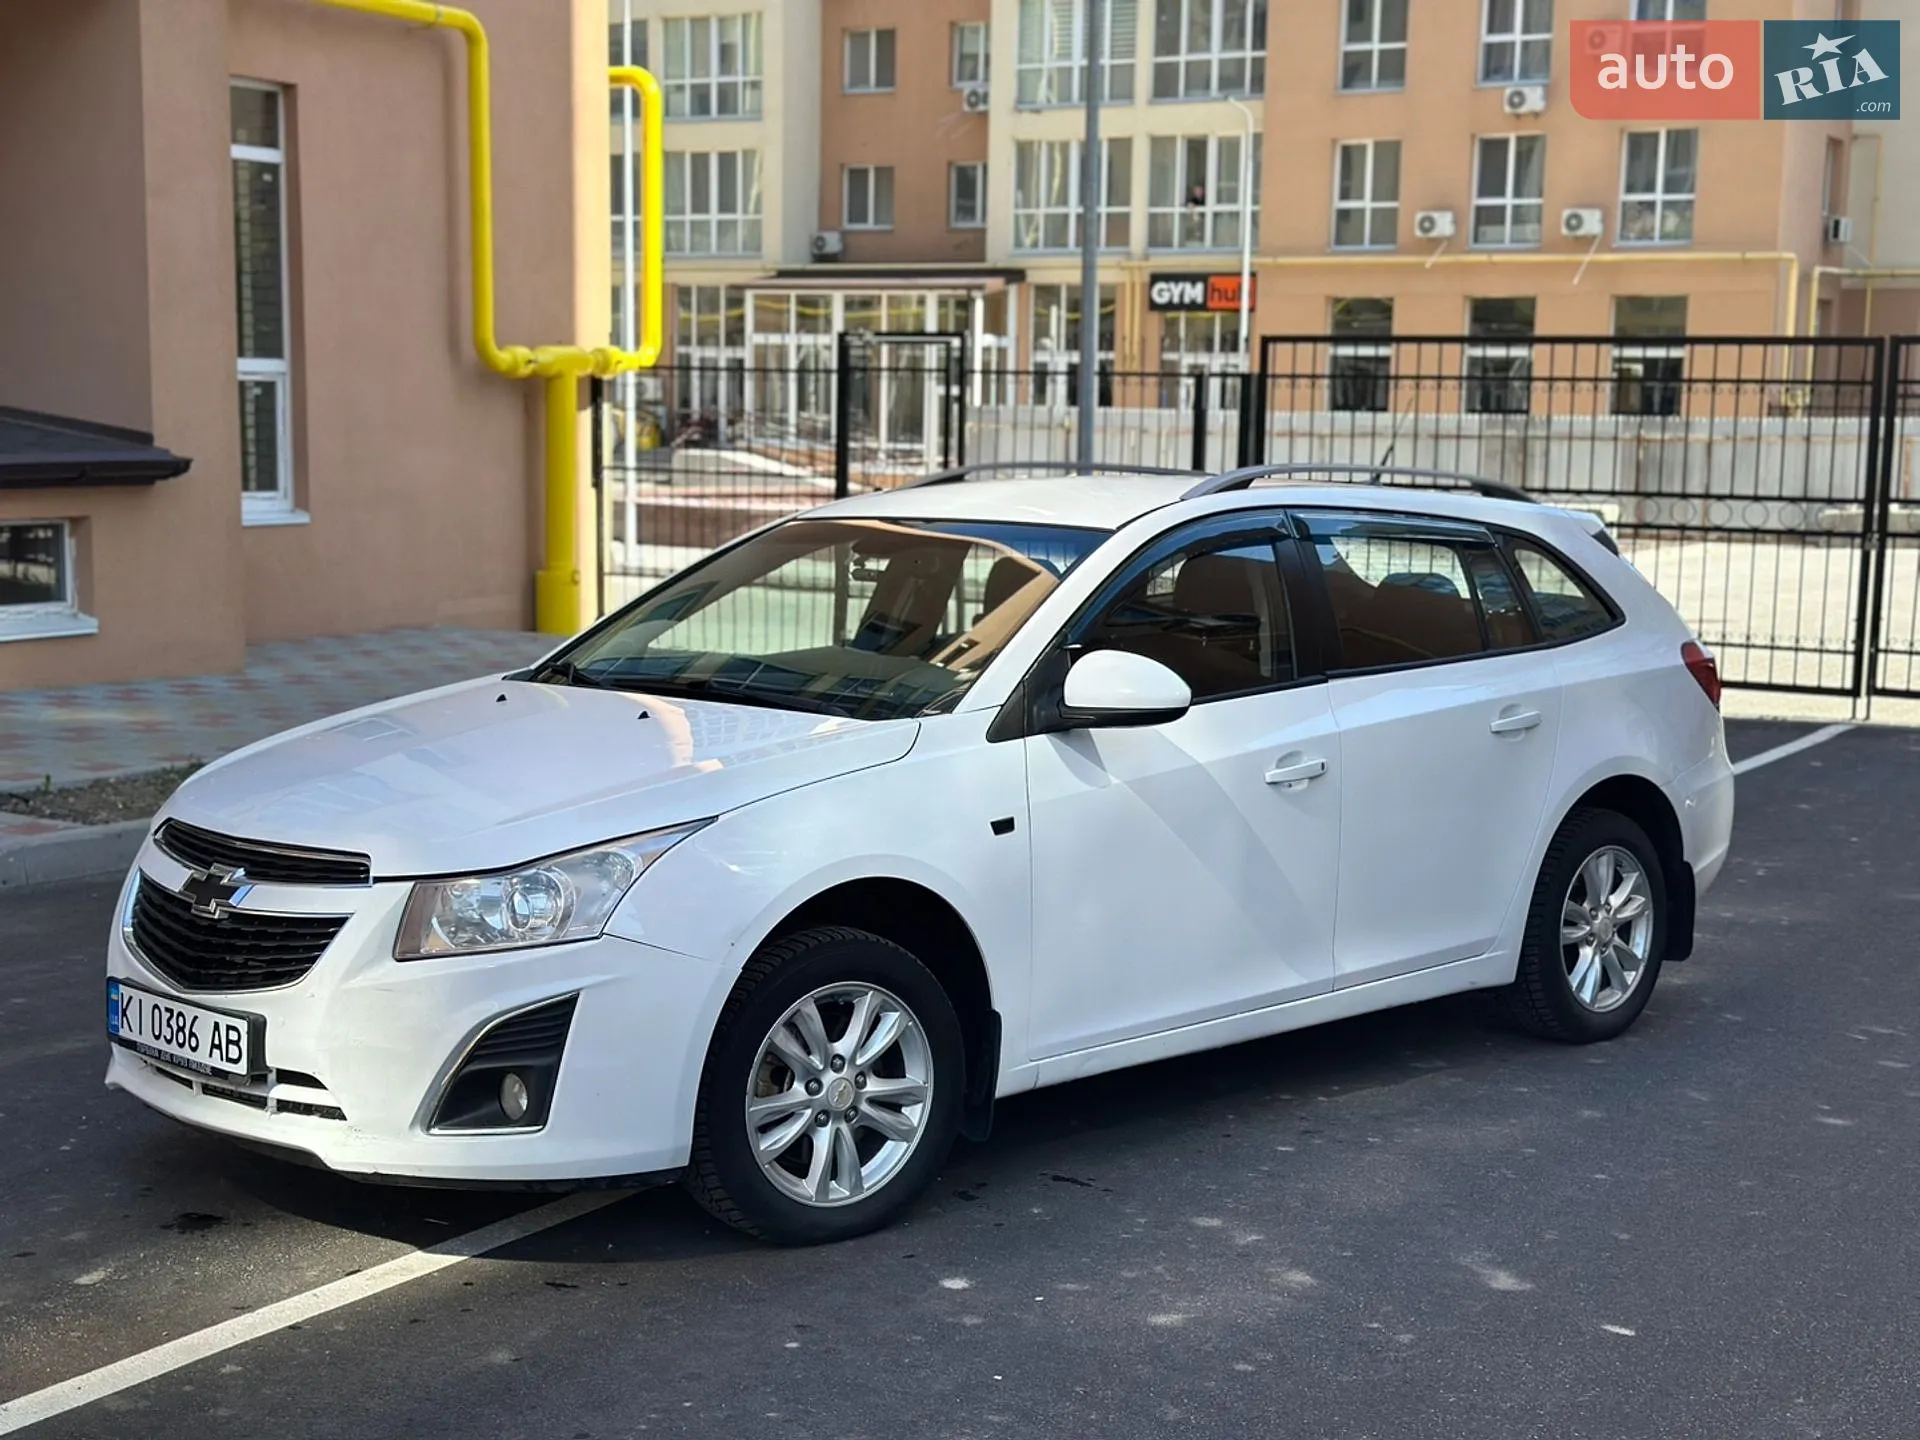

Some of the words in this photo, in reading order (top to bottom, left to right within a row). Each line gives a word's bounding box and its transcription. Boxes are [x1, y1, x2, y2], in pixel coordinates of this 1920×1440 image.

[1151, 281, 1204, 305] GYM
[120, 992, 143, 1036] KI
[151, 1003, 199, 1053] 0386
[208, 1021, 243, 1065] AB
